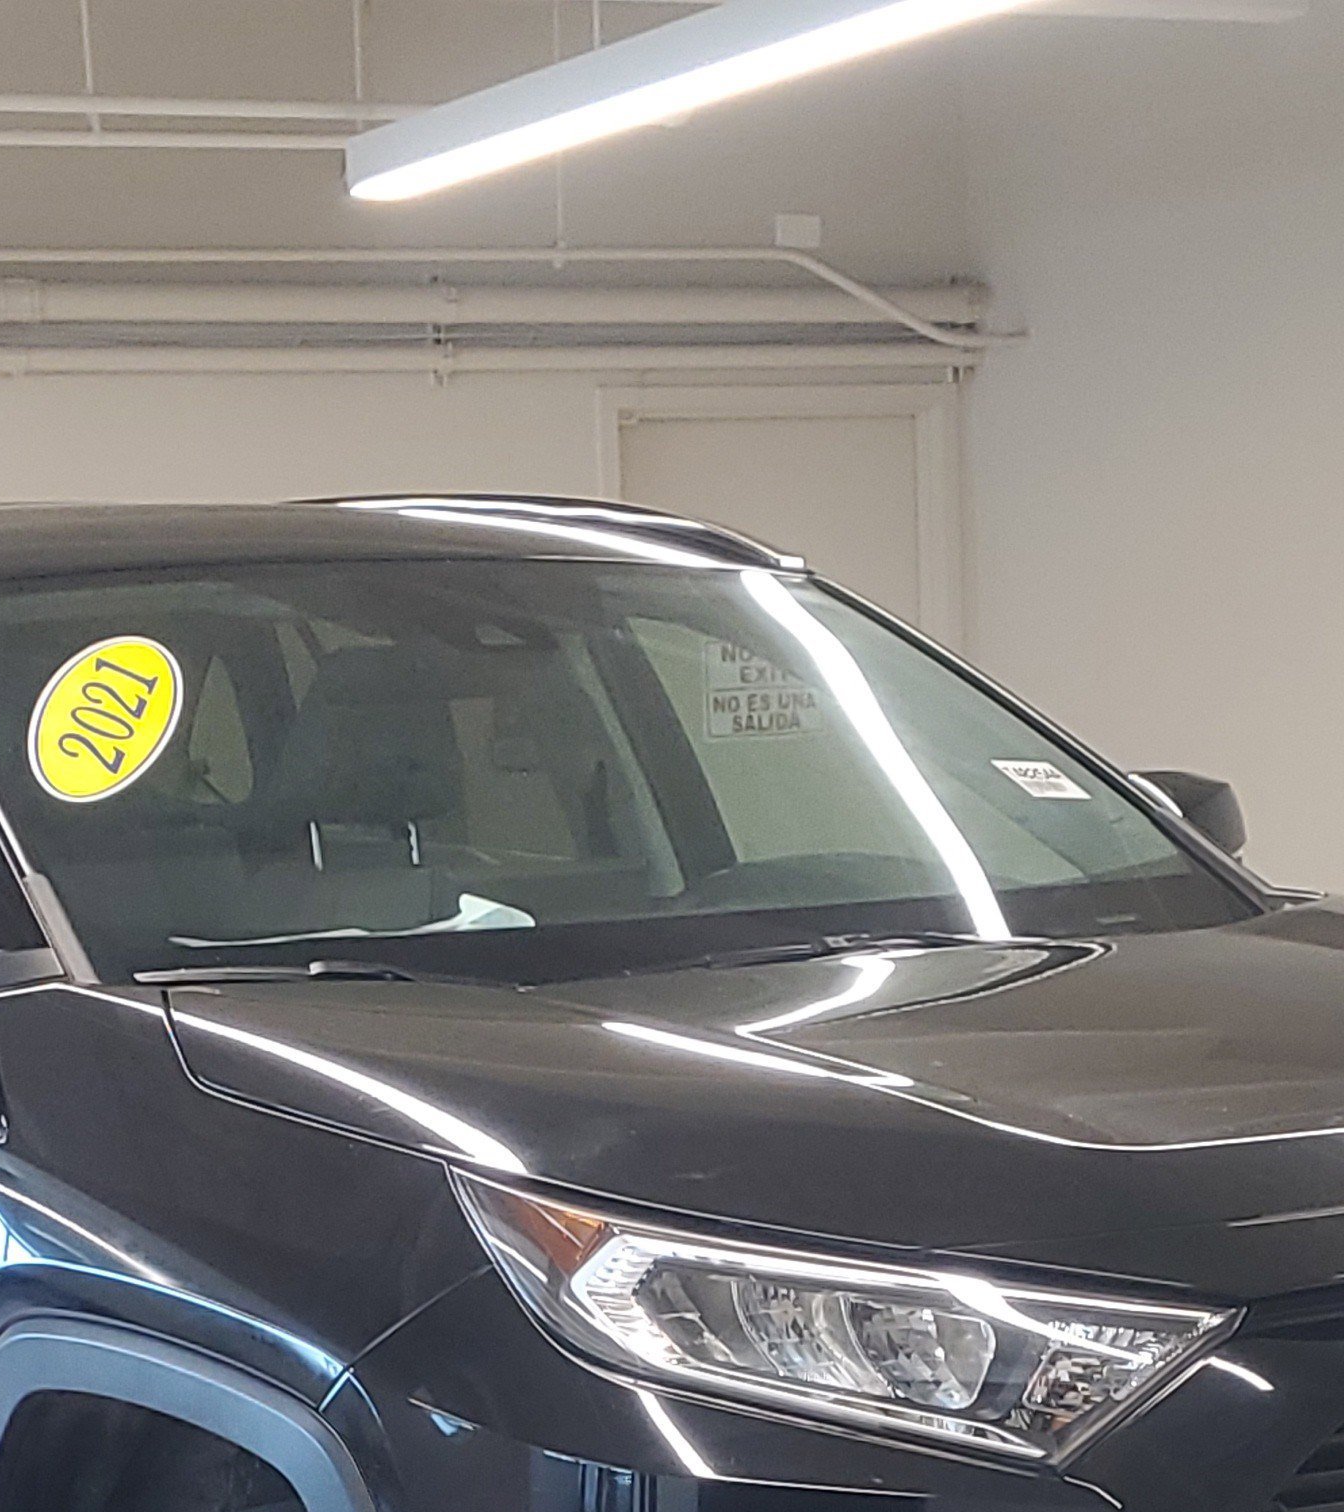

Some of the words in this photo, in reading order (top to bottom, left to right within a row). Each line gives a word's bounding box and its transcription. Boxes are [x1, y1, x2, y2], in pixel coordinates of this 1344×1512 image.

[713, 695, 740, 713] NO
[747, 693, 770, 711] ES
[58, 657, 158, 775] 2021
[732, 713, 801, 733] SALIDA
